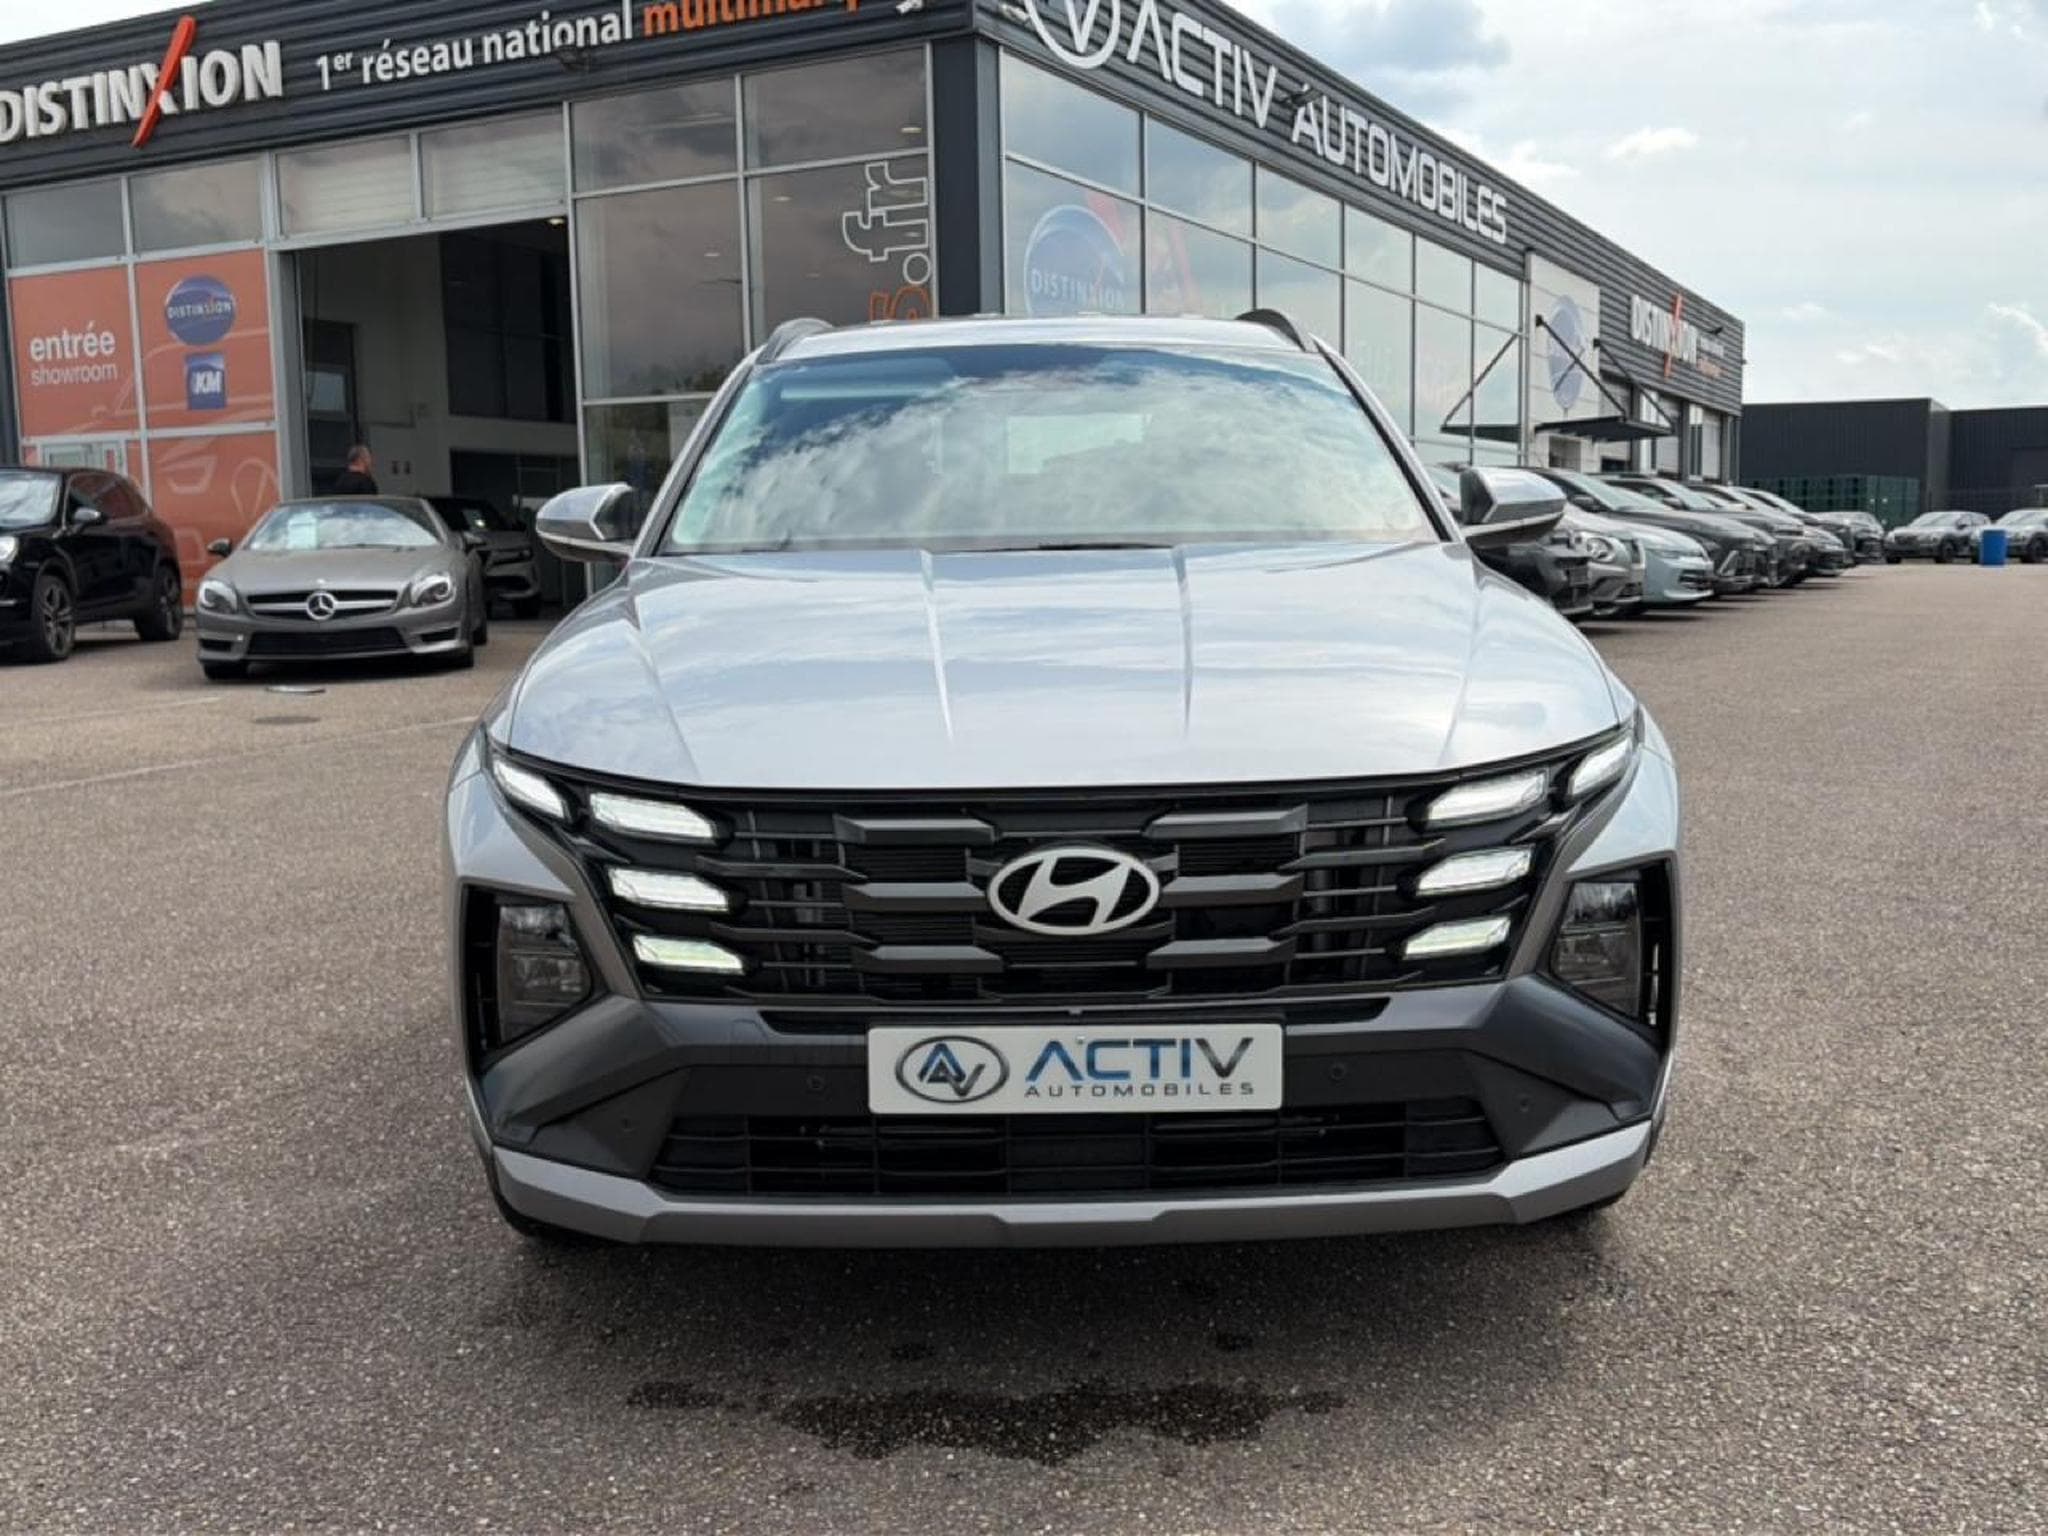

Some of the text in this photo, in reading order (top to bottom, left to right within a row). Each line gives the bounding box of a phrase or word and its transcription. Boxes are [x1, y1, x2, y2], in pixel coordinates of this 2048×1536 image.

[316, 50, 353, 90] 1er
[362, 38, 474, 84] réseau
[482, 0, 633, 63] national
[1127, 0, 1506, 244] ACTIV AUTOMOBILES
[30, 320, 116, 361] entrée
[31, 361, 118, 386] showroom
[1025, 1036, 1255, 1082] ACTIV
[1024, 1081, 1255, 1098] AUTOMOBILES
